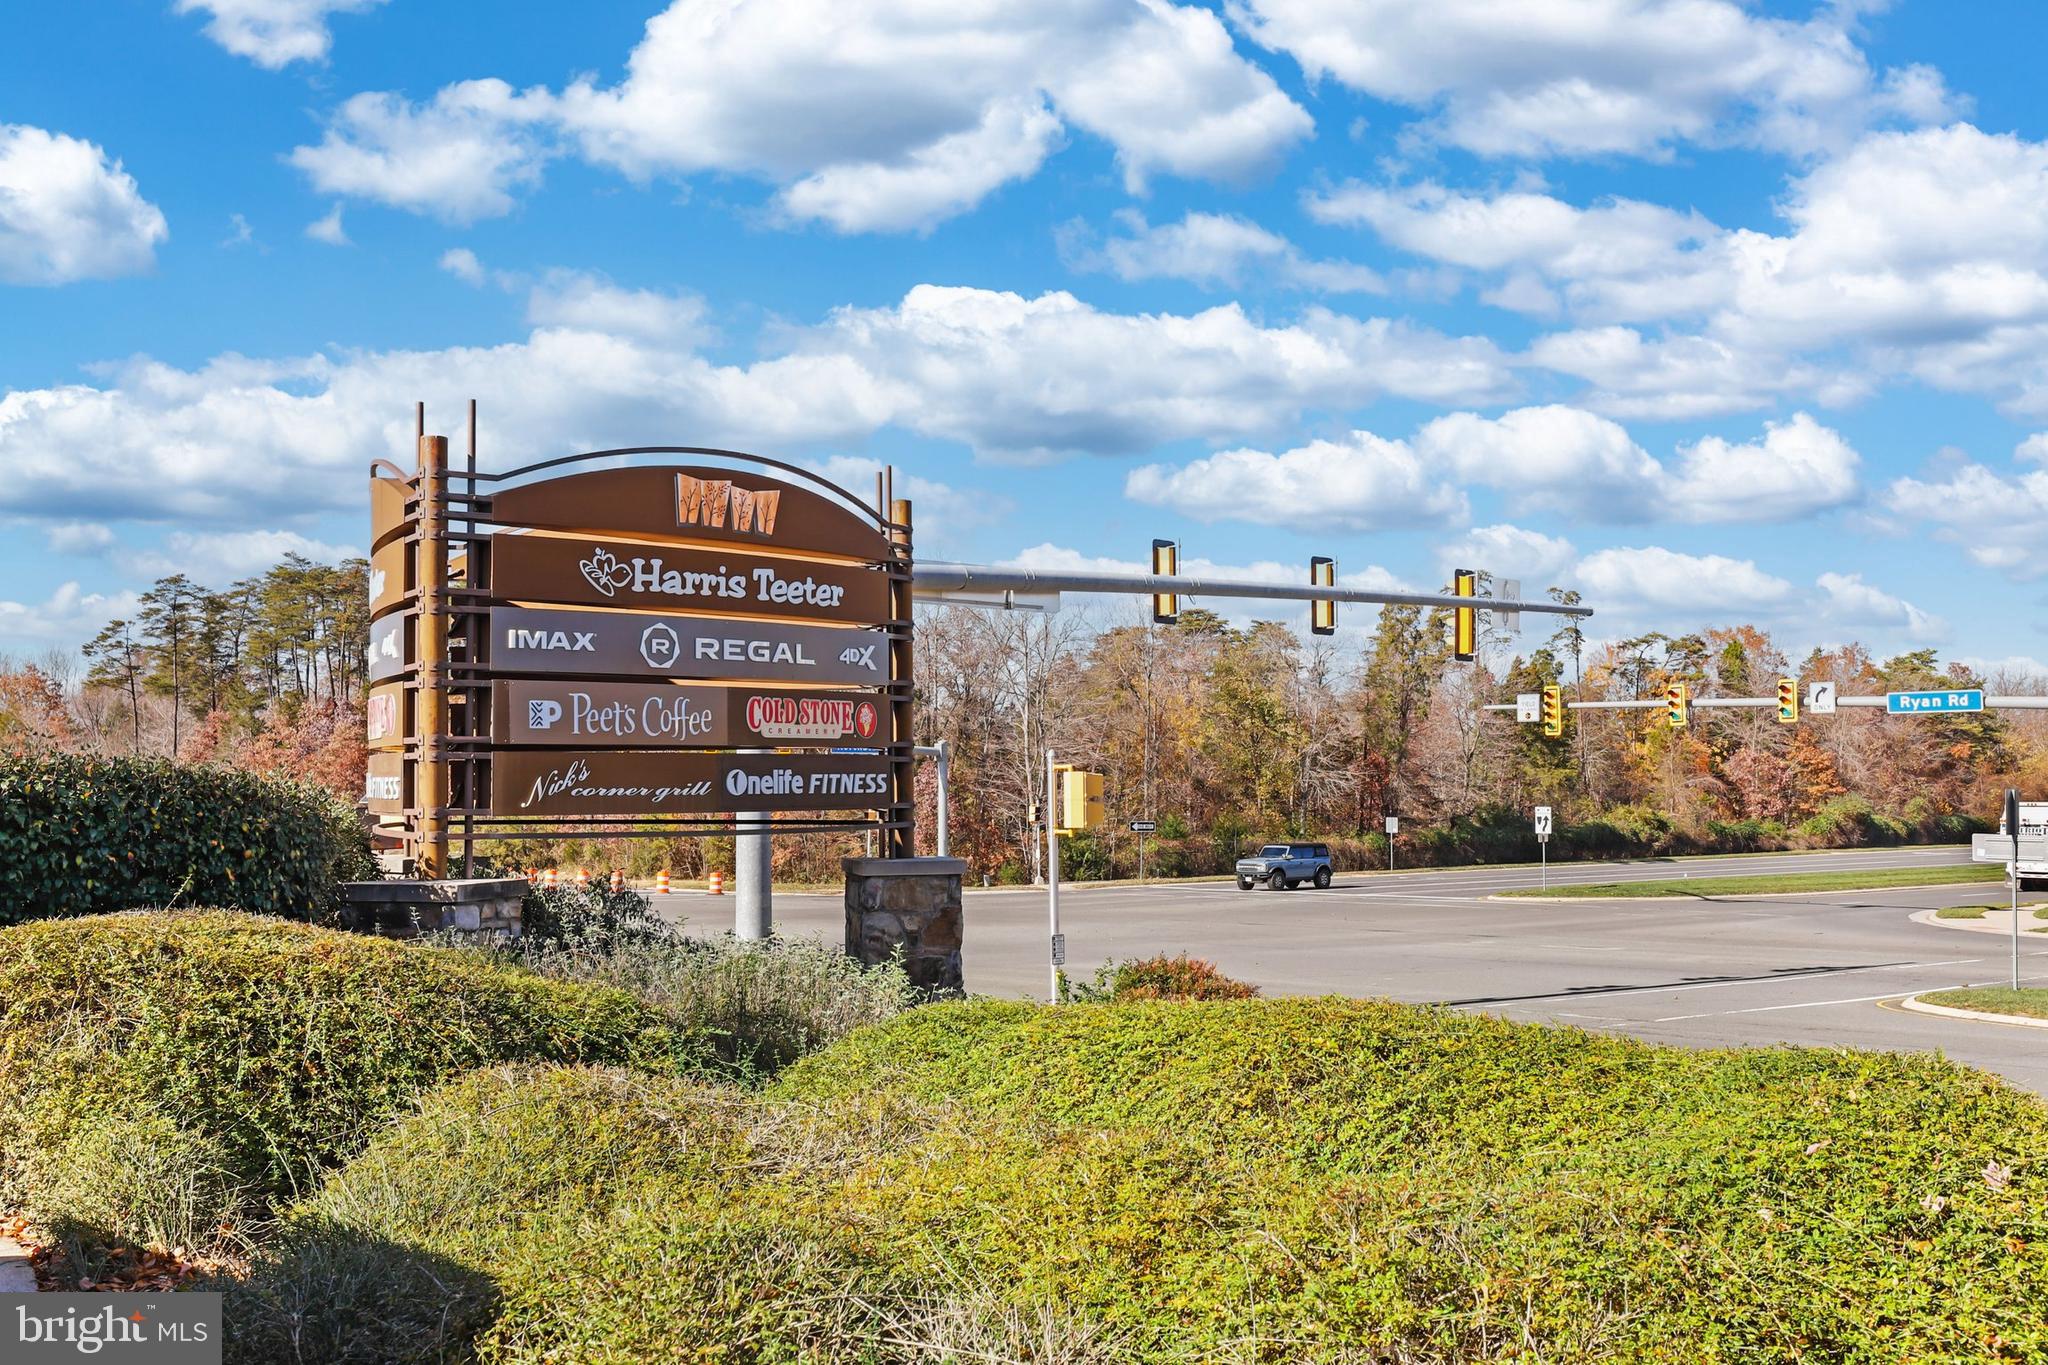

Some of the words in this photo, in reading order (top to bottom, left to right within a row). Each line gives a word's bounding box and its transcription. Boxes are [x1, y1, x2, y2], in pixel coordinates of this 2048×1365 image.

[631, 558, 747, 599] Harris
[752, 568, 844, 608] Teeter
[508, 629, 596, 652] IMAX
[651, 638, 670, 655] R
[695, 637, 816, 665] REGAL
[838, 645, 878, 671] 4DX
[747, 697, 798, 732] COLD
[799, 698, 854, 733] STONE
[1900, 695, 1942, 711] Ryan
[1948, 693, 1969, 707] Rd
[568, 693, 636, 737] Peet's
[642, 697, 712, 741] Coffee
[768, 727, 837, 735] CREAMERY
[520, 759, 591, 808] Nick's
[571, 784, 653, 798] corner
[652, 781, 712, 803] grill
[726, 769, 804, 796] Onelife
[808, 772, 888, 795] FITNESS
